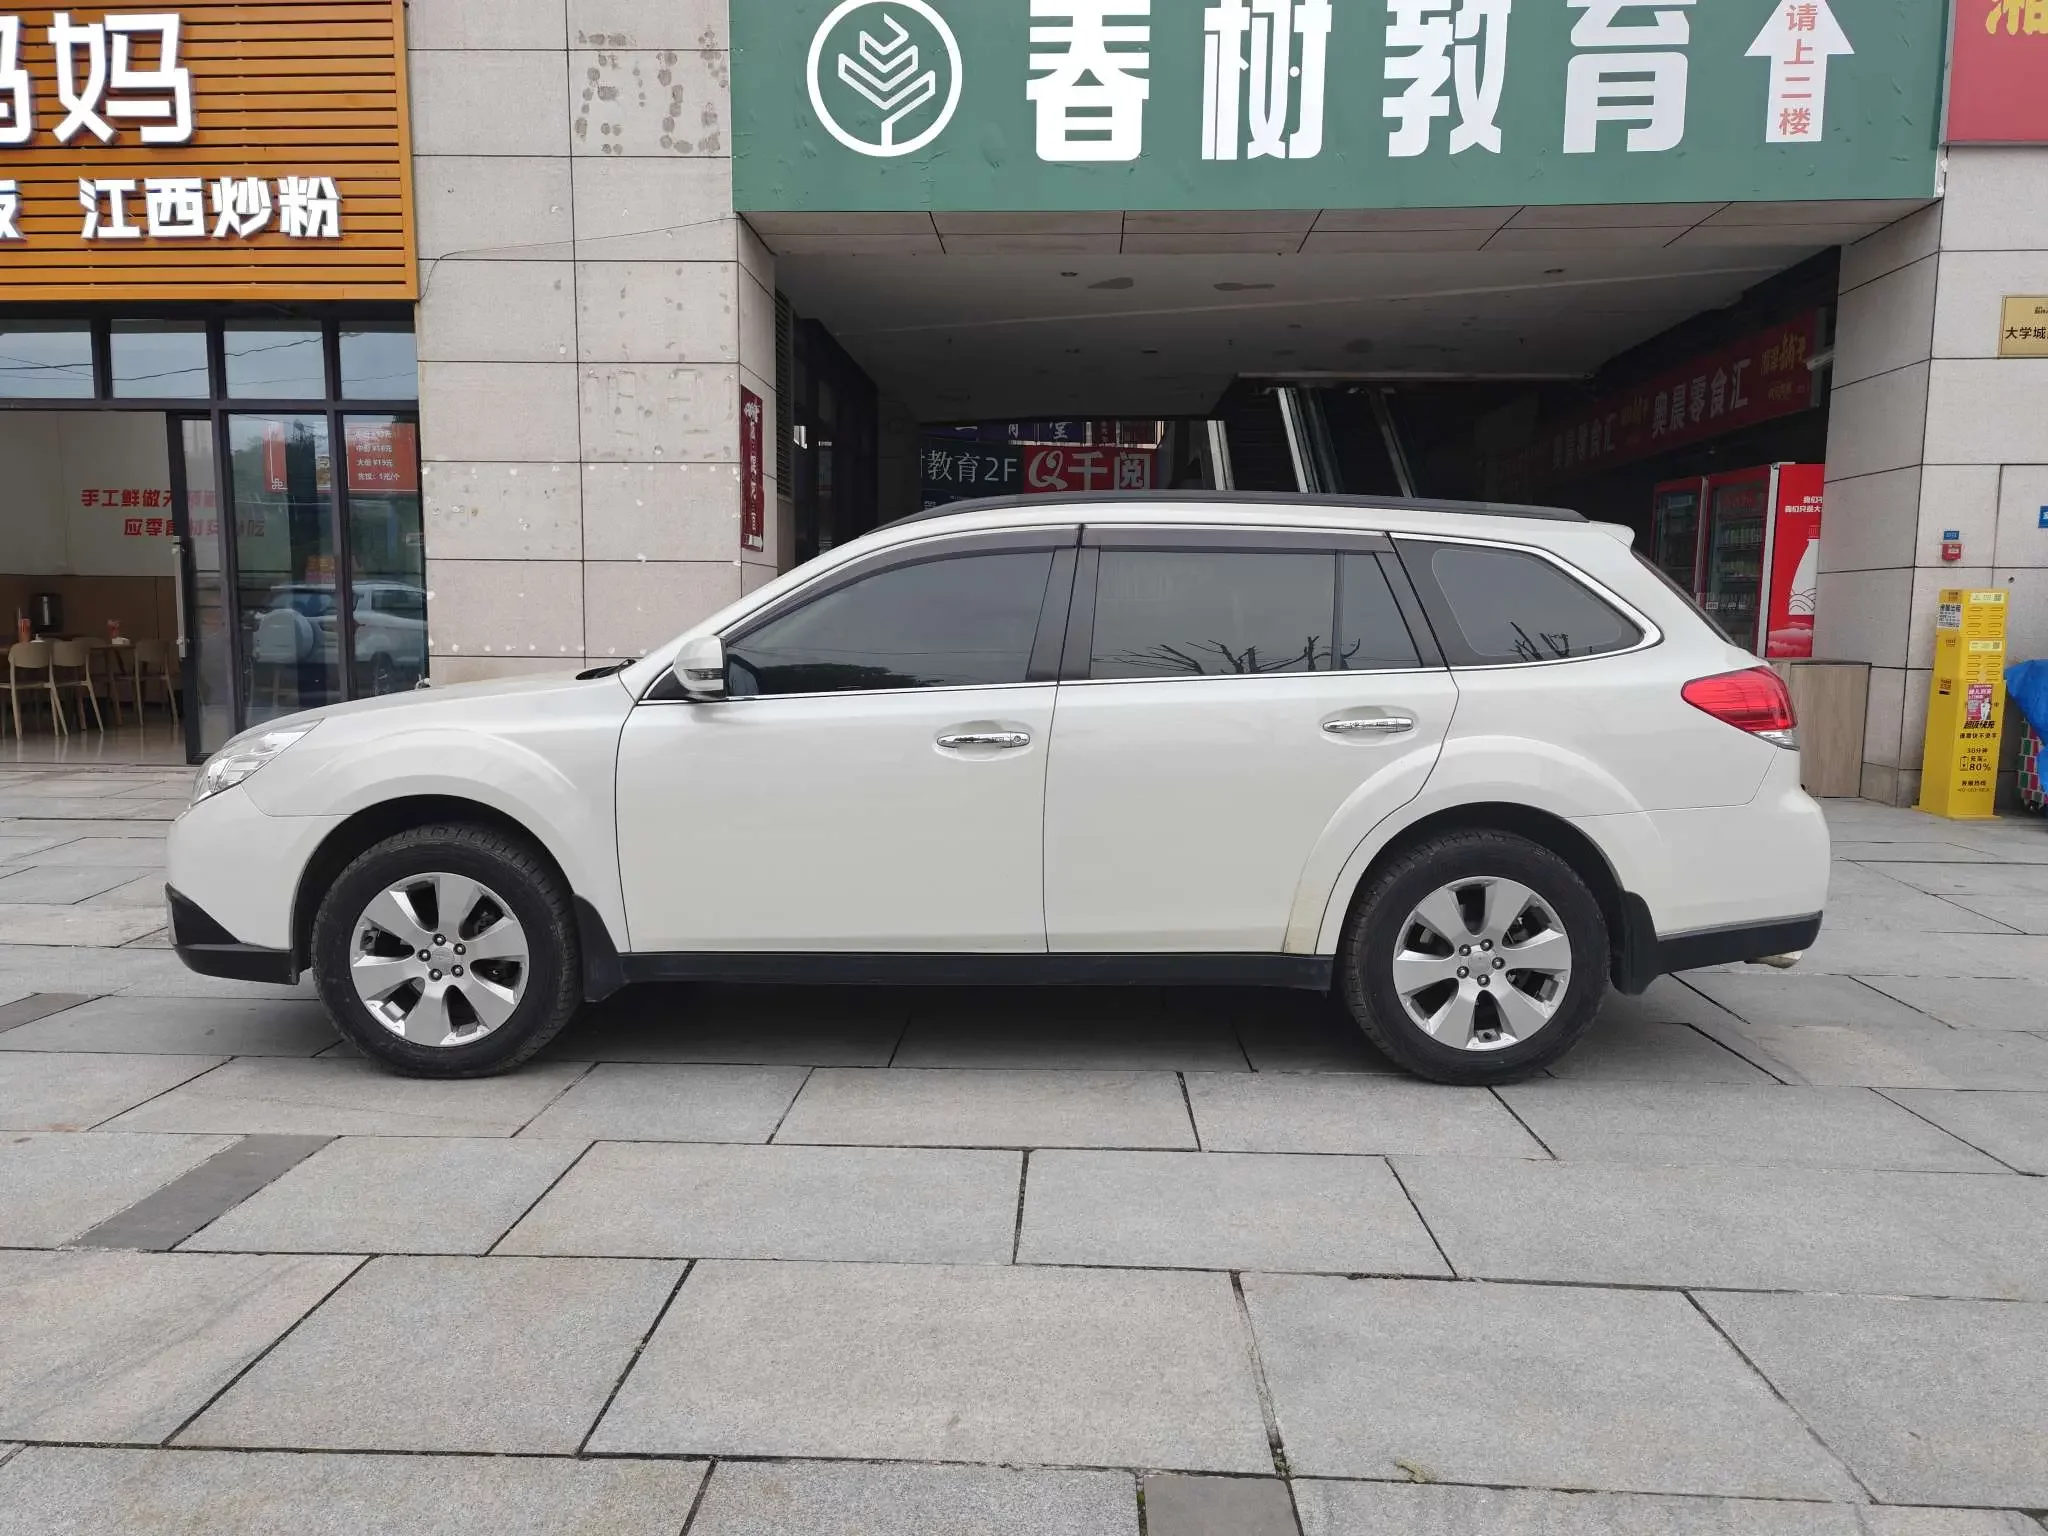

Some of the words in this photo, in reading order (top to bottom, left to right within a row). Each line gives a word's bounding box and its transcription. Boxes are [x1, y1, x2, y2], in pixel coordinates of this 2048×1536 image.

[1026, 0, 1691, 162] 春树教育
[1779, 3, 1817, 138] 请上二楼
[79, 176, 344, 239] 江西炒粉
[2005, 326, 2048, 340] 大学城
[920, 449, 1018, 483] 教育2F
[1969, 763, 1991, 772] 80%
